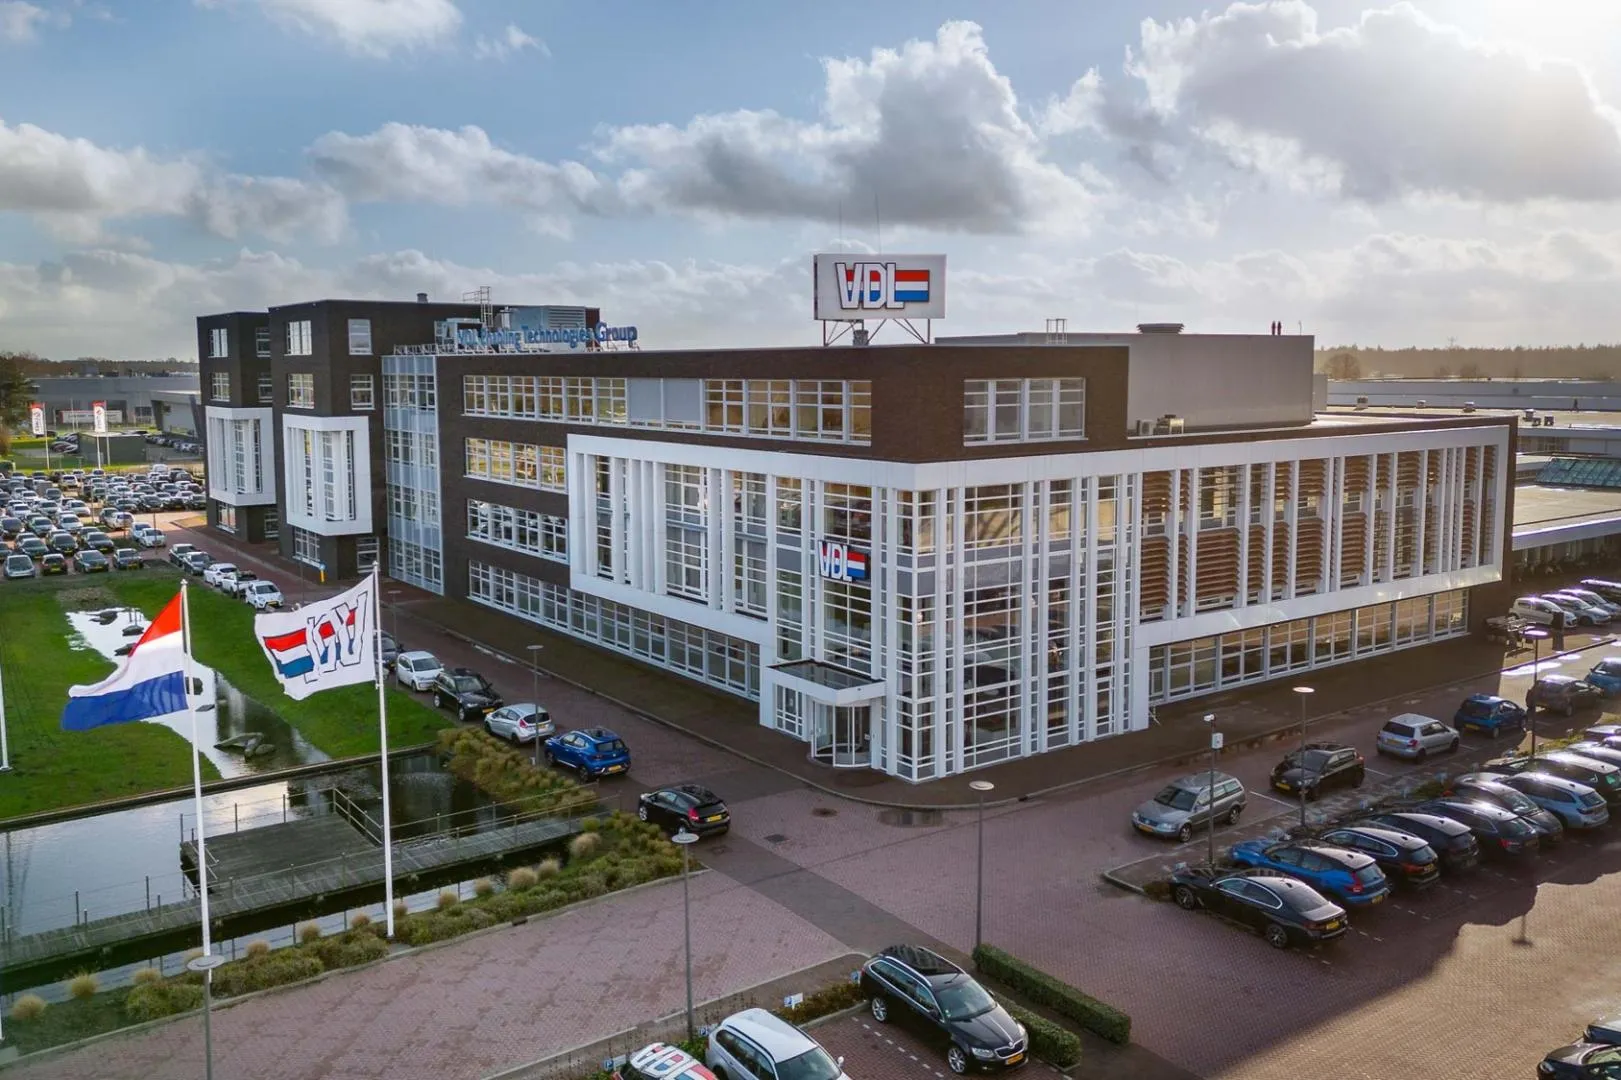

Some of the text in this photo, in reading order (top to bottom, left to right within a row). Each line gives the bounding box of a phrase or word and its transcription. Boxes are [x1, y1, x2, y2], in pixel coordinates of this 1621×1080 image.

[834, 262, 904, 309] VDL
[521, 324, 591, 348] Technologies
[595, 321, 638, 348] Group
[817, 540, 852, 582] VDL
